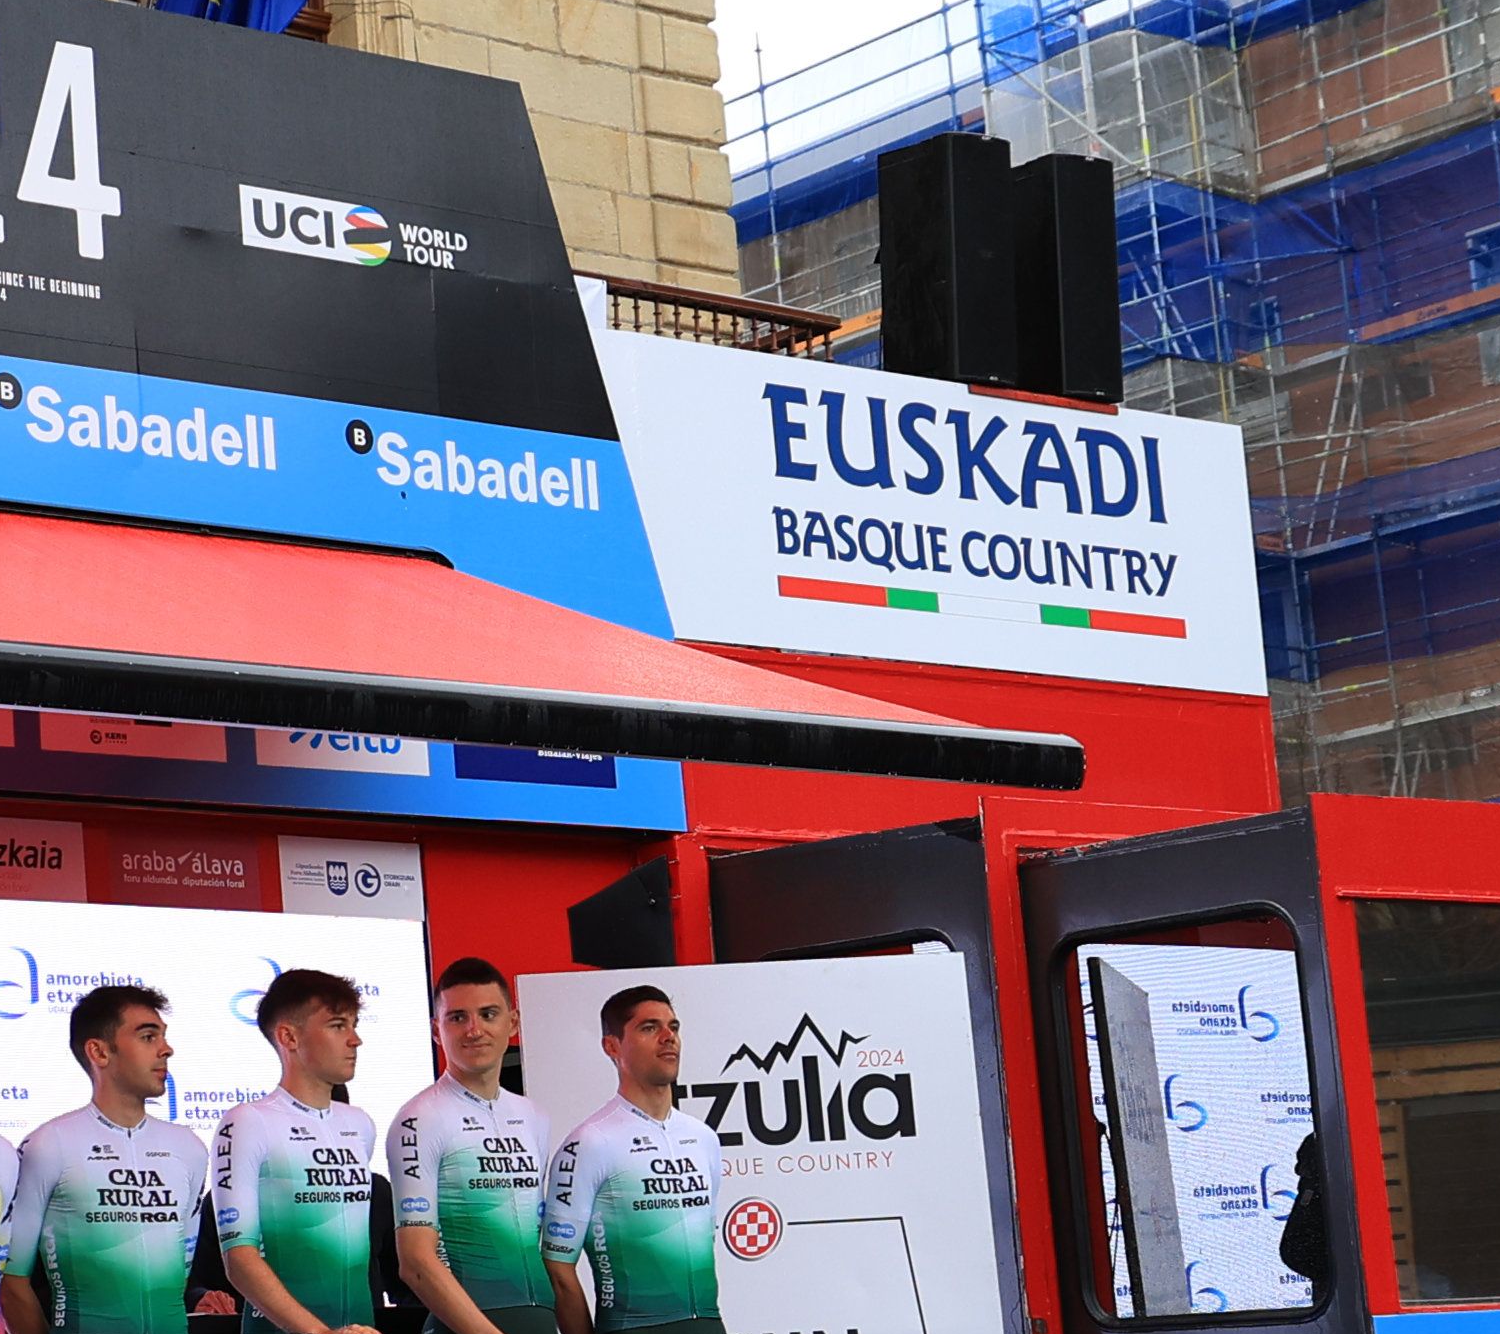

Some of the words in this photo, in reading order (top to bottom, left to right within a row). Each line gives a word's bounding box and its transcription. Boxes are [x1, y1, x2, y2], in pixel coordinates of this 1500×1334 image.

[252, 198, 334, 249] UCI
[399, 223, 468, 253] WORLD
[402, 243, 456, 270] TOUR
[29, 275, 46, 292] THE
[49, 277, 101, 300] BEGINNING
[26, 386, 277, 471] Sabadell
[376, 430, 599, 511] Sabadell
[762, 381, 1168, 525] EUSKADI
[771, 505, 952, 574] BASQUE
[960, 529, 1178, 597] COUNTRY
[857, 1049, 904, 1068] 2024
[777, 1151, 893, 1174] COUNTRY
